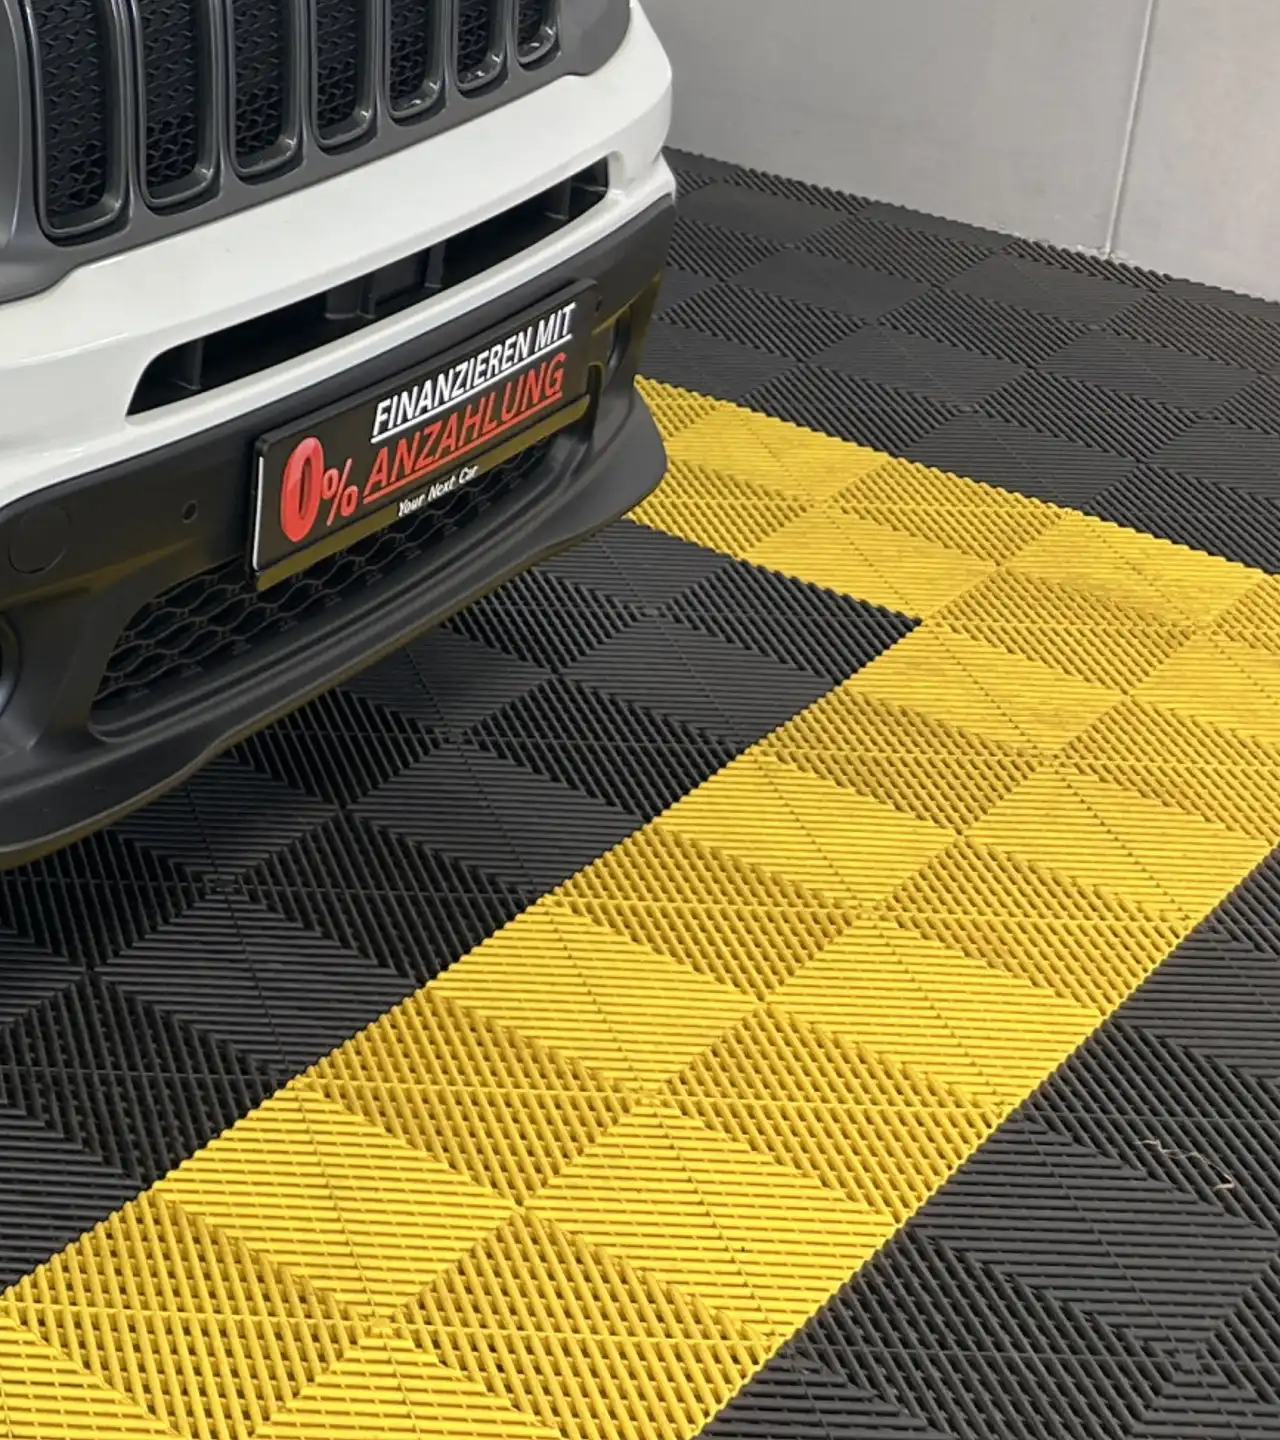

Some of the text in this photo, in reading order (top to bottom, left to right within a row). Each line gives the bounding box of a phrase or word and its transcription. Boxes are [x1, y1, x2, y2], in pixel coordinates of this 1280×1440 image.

[372, 302, 576, 437] FINANZIEREN MIT
[280, 352, 568, 543] 0% ANZAHLUNG
[398, 493, 427, 518] Your
[427, 474, 457, 503] Next
